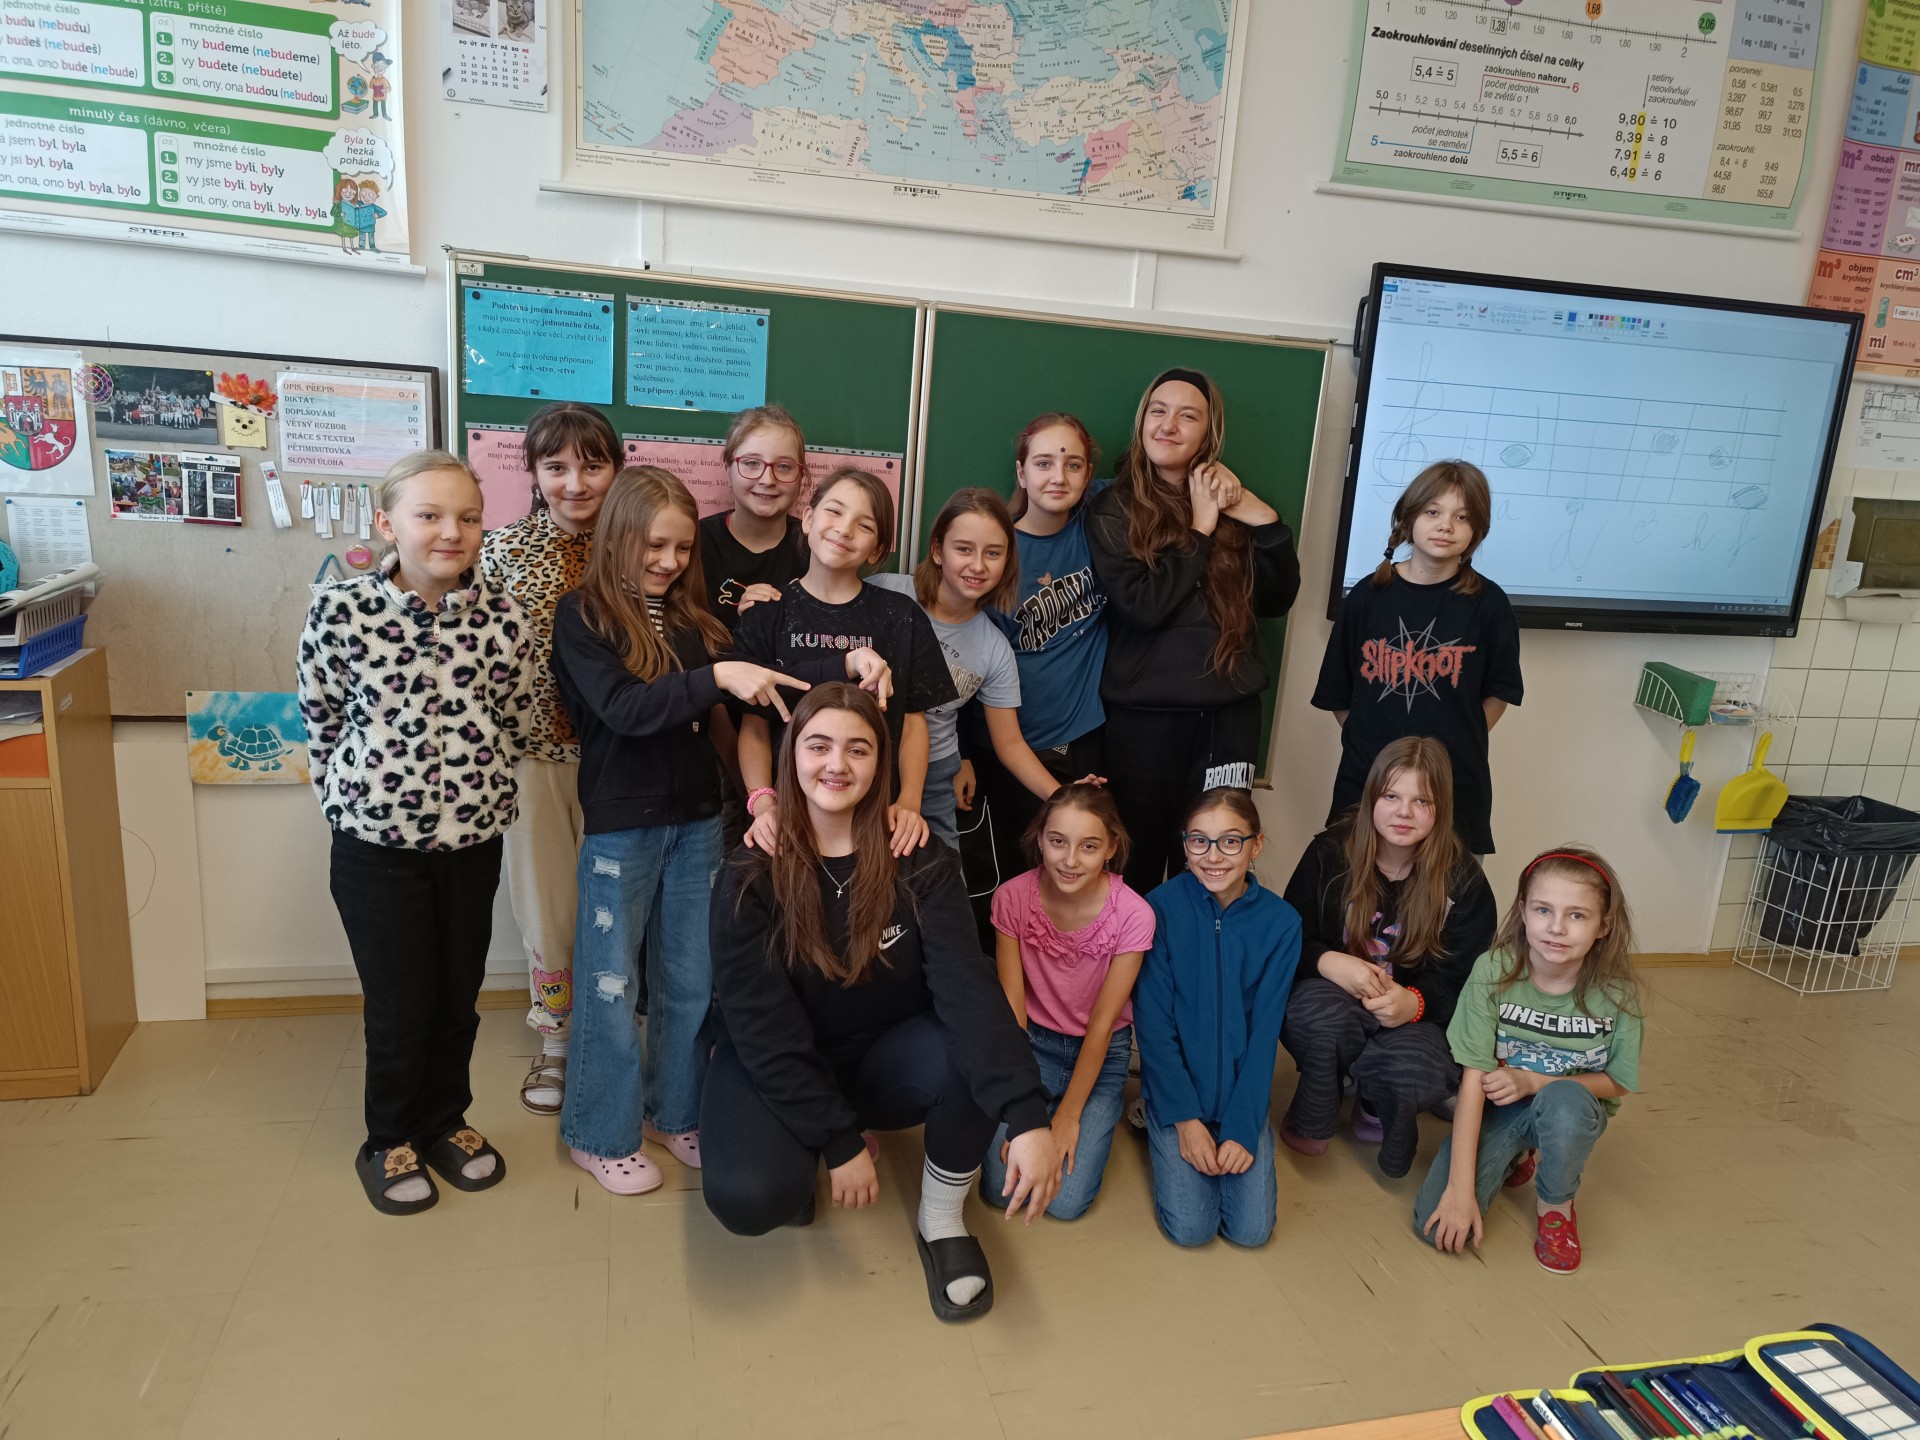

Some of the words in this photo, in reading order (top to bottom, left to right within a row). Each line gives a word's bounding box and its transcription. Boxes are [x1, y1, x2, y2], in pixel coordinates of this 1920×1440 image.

[187, 2, 227, 17] příště)
[6, 15, 35, 28] budu
[39, 18, 90, 34] (nebudu)
[189, 21, 235, 36] množné
[238, 27, 263, 40] číslo
[1491, 18, 1506, 33] 1,39
[1699, 18, 1716, 30] 2,06
[338, 28, 350, 38] Až
[352, 30, 376, 40] bude
[700, 12, 733, 61] PORTUGALSKO
[6, 34, 41, 48] budeš
[44, 38, 102, 55] (nebudeš)
[181, 36, 199, 49] my
[202, 38, 250, 55] budeme
[252, 46, 320, 66] (nebudeme)
[341, 39, 362, 50] léto.
[1371, 26, 1458, 50] Zaokrouhlování
[1459, 40, 1518, 60] desetinných
[1520, 48, 1544, 63] čísel
[1544, 54, 1557, 66] na
[1558, 56, 1584, 71] celky
[61, 60, 88, 73] bude
[90, 65, 138, 80] (nebude)
[182, 56, 195, 69] vy
[198, 57, 238, 73] budete
[242, 64, 303, 82] (nebudete)
[1414, 64, 1433, 79] 5,4
[1446, 69, 1455, 81] 5
[1484, 64, 1536, 80] zaokrouhleno
[1537, 72, 1567, 84] nahoru
[1652, 74, 1674, 84] setiny
[225, 82, 244, 93] ona
[246, 83, 278, 98] budou
[280, 87, 328, 105] (nebudou)
[1647, 94, 1698, 108] zaokrouhlení
[1376, 90, 1389, 101] 5,0
[1396, 92, 1407, 102] 5,1
[1415, 94, 1428, 106] 5,2
[1434, 98, 1447, 108] 5,3
[1454, 100, 1466, 110] 5,4
[1472, 102, 1485, 113] 5,5
[1491, 104, 1504, 116] 5,6
[1510, 107, 1522, 118] 5,7
[1528, 110, 1541, 121] 5,8
[1546, 112, 1559, 123] 5,9
[1564, 115, 1577, 126] 6,0
[69, 107, 115, 122] minulý
[118, 113, 140, 124] čas
[144, 114, 190, 131] (dávno,
[194, 121, 231, 136] včera)
[1618, 112, 1646, 126] 9,80
[1663, 118, 1678, 130] 10
[1412, 124, 1435, 136] počet
[1435, 126, 1470, 140] jednotek
[1615, 130, 1642, 144] 8,39
[1660, 134, 1668, 146] 8
[344, 134, 364, 146] Byla
[366, 137, 376, 146] to
[1428, 138, 1438, 147] se
[1438, 138, 1468, 151] nemění
[347, 145, 374, 156] hezká
[846, 136, 861, 167] TUNISKO
[1394, 148, 1448, 163] zaokrouhleno
[1450, 153, 1469, 165] dolů
[1500, 147, 1518, 160] 5,5
[1530, 151, 1539, 163] 6
[1614, 148, 1638, 162] 7,91
[1657, 152, 1666, 164] 8
[340, 156, 382, 168] pohádka.
[1870, 153, 1896, 164] obsah
[185, 155, 203, 168] my
[206, 156, 232, 170] jsme
[261, 163, 285, 178] byly
[1610, 166, 1636, 179] 6,49
[1654, 169, 1662, 181] 6
[186, 175, 200, 188] vy
[202, 176, 221, 188] jste
[250, 181, 274, 196] byly
[894, 186, 942, 195] STIEFEL
[232, 199, 252, 210] ona
[305, 206, 328, 219] byla
[129, 226, 188, 238] STIEFEL
[1848, 263, 1874, 274] objem
[1854, 285, 1871, 293] metr
[555, 308, 593, 318] hromadná
[541, 318, 582, 329] jednotného
[1869, 334, 1888, 350] ml
[306, 383, 335, 392] PŘEPIS
[284, 396, 314, 404] DIKTÁT
[286, 407, 336, 418] DOPLŇOVÁNÍ
[286, 420, 312, 428] VĚTNÝ
[314, 422, 346, 430] ROZBOR
[286, 432, 314, 440] PRÁCE
[322, 434, 356, 443] TEXTEM
[288, 444, 352, 454] PĚTIMINUTOVKA
[288, 456, 316, 464] SLOVNÍ
[318, 457, 344, 466] ÚLOHA
[790, 633, 873, 650] KUROMI
[951, 648, 960, 658] TO
[882, 924, 902, 940] NIKE
[1500, 1002, 1614, 1036] MINECRAFT
